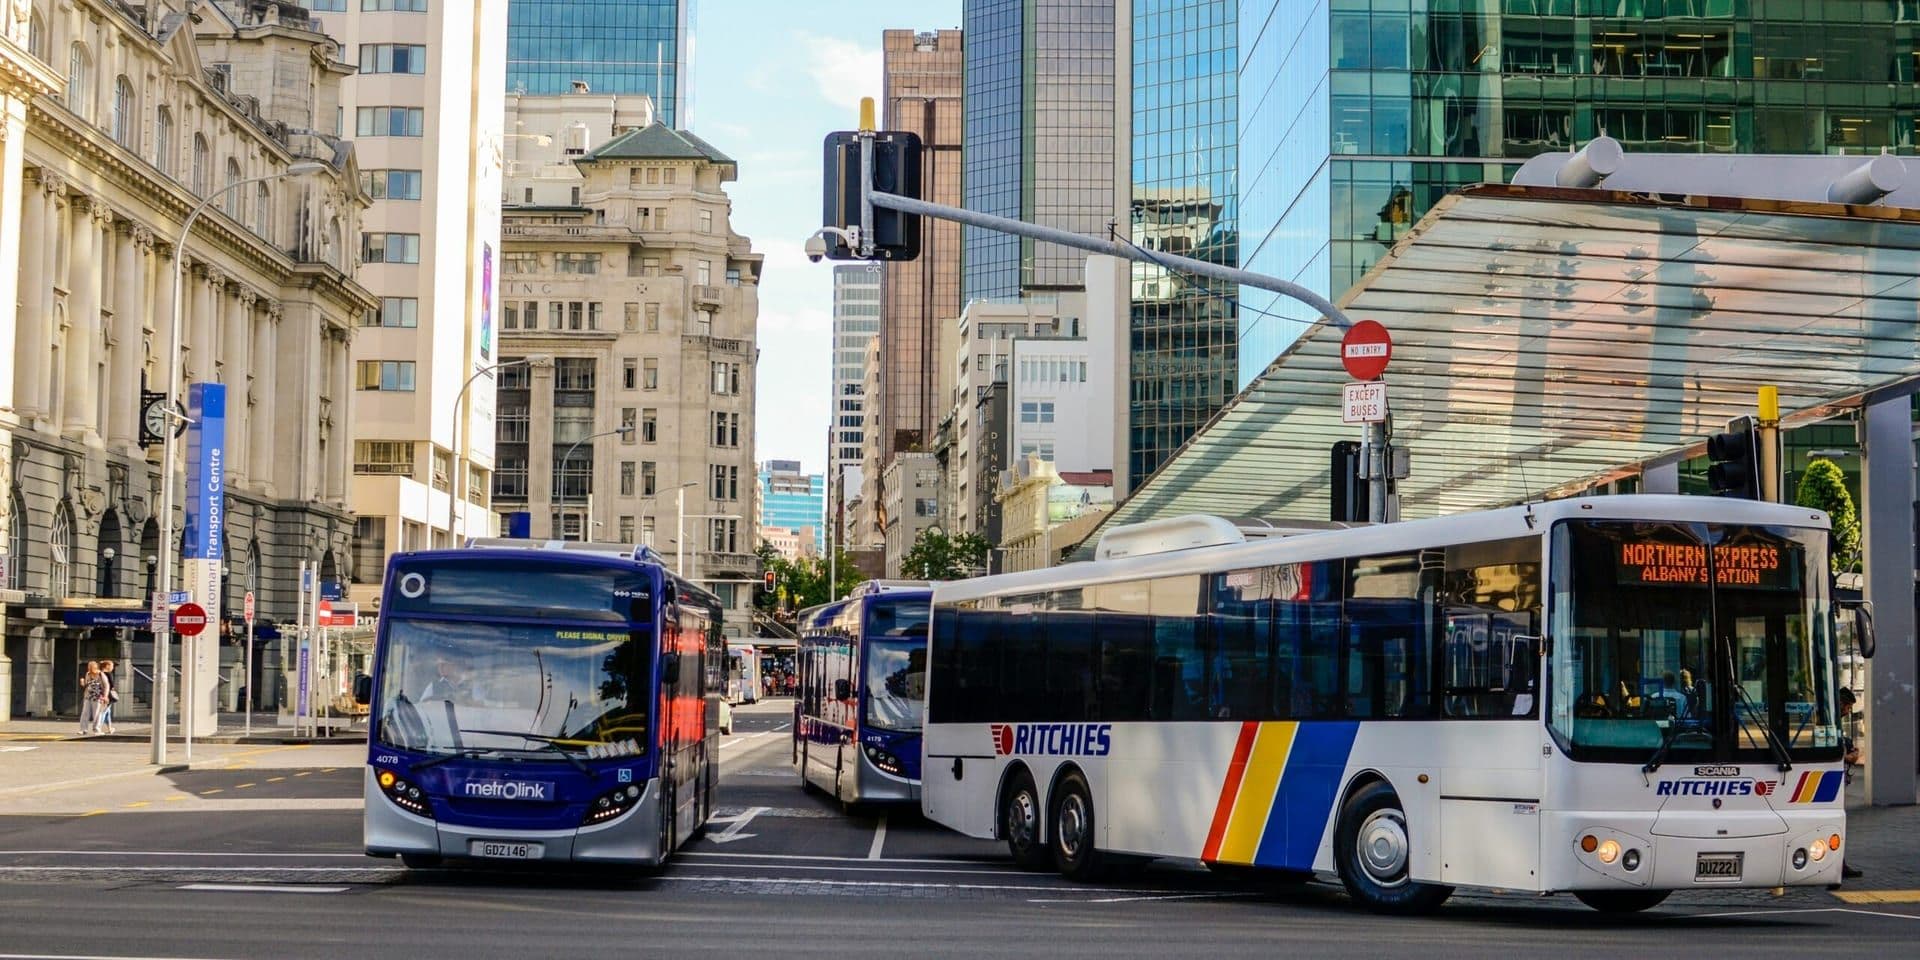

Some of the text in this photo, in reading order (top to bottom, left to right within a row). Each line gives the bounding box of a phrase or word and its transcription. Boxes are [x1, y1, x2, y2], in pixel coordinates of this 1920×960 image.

[1350, 345, 1381, 355] NO ENTRY
[1349, 388, 1380, 401] EXCEPT
[1350, 404, 1378, 416] BUSES
[206, 448, 221, 624] Britomart Transport Centre
[1623, 543, 1705, 567] NORTHERN
[1642, 566, 1760, 584] ALBANY SATION
[556, 631, 580, 640] PLEASE
[582, 632, 604, 640] SIGNAL
[1014, 724, 1112, 756] RITCHIES
[376, 755, 399, 764] 4078
[1698, 766, 1738, 776] SCANIA
[1656, 780, 1752, 796] RITCHIES
[485, 844, 526, 857] GDZ146
[1699, 861, 1738, 875] DUZ221
